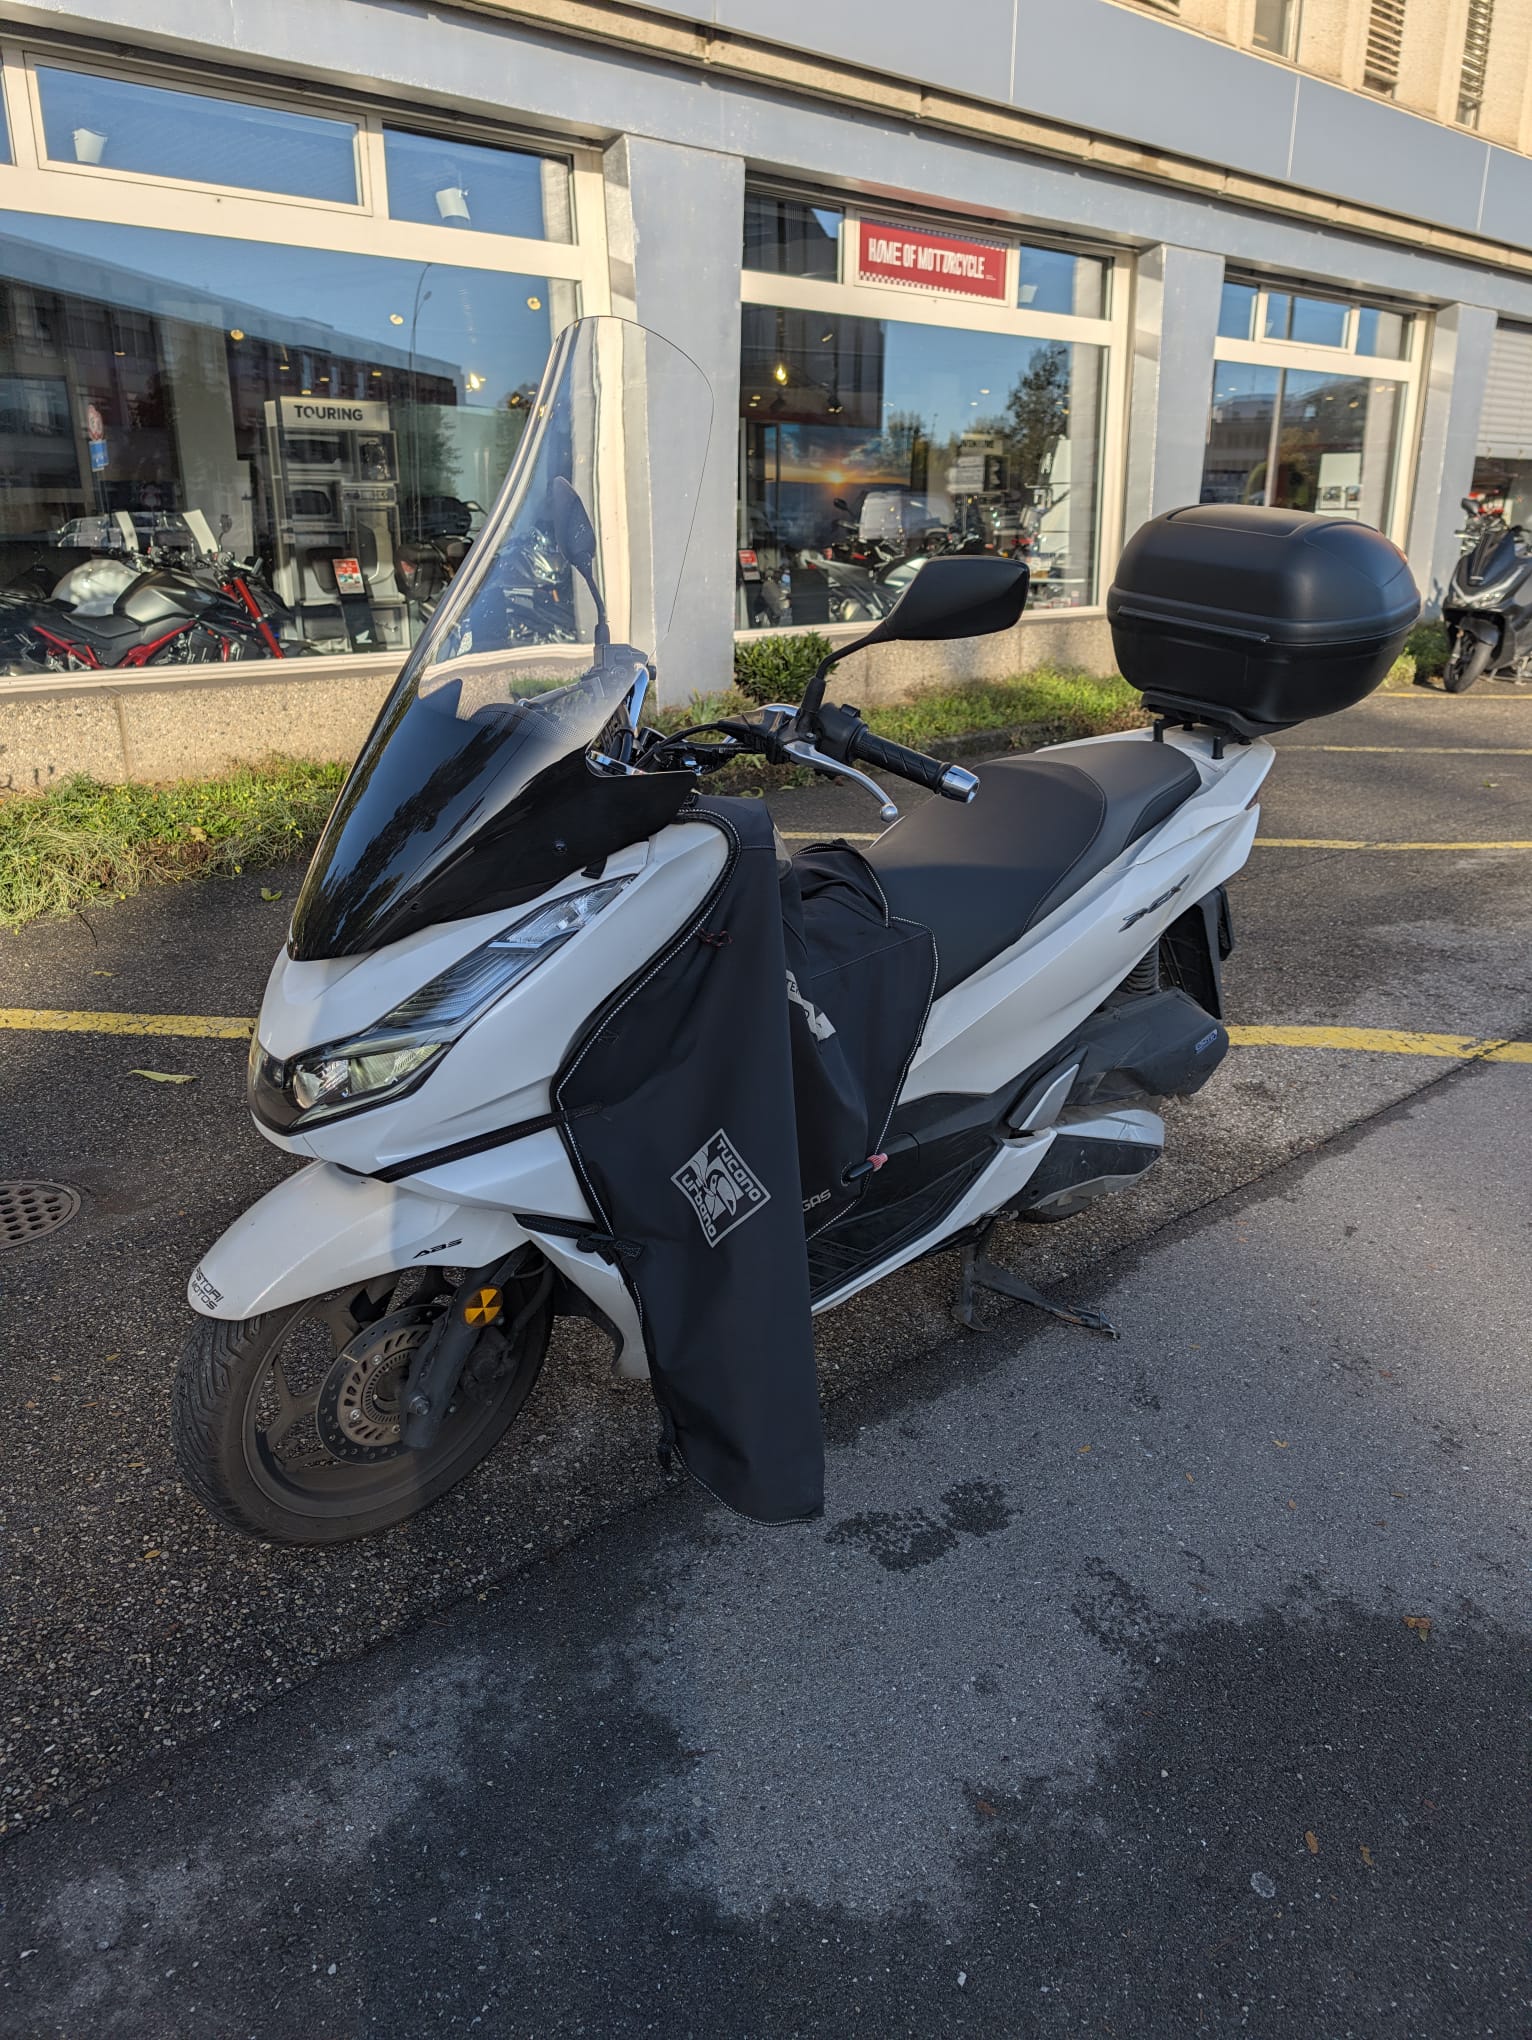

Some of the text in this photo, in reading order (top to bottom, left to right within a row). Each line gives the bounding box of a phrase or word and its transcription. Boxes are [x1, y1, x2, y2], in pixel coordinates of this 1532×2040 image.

[903, 244, 917, 268] OF
[294, 405, 363, 421] TOURING
[412, 1237, 463, 1259] ABS
[191, 1280, 218, 1310] MOTOS
